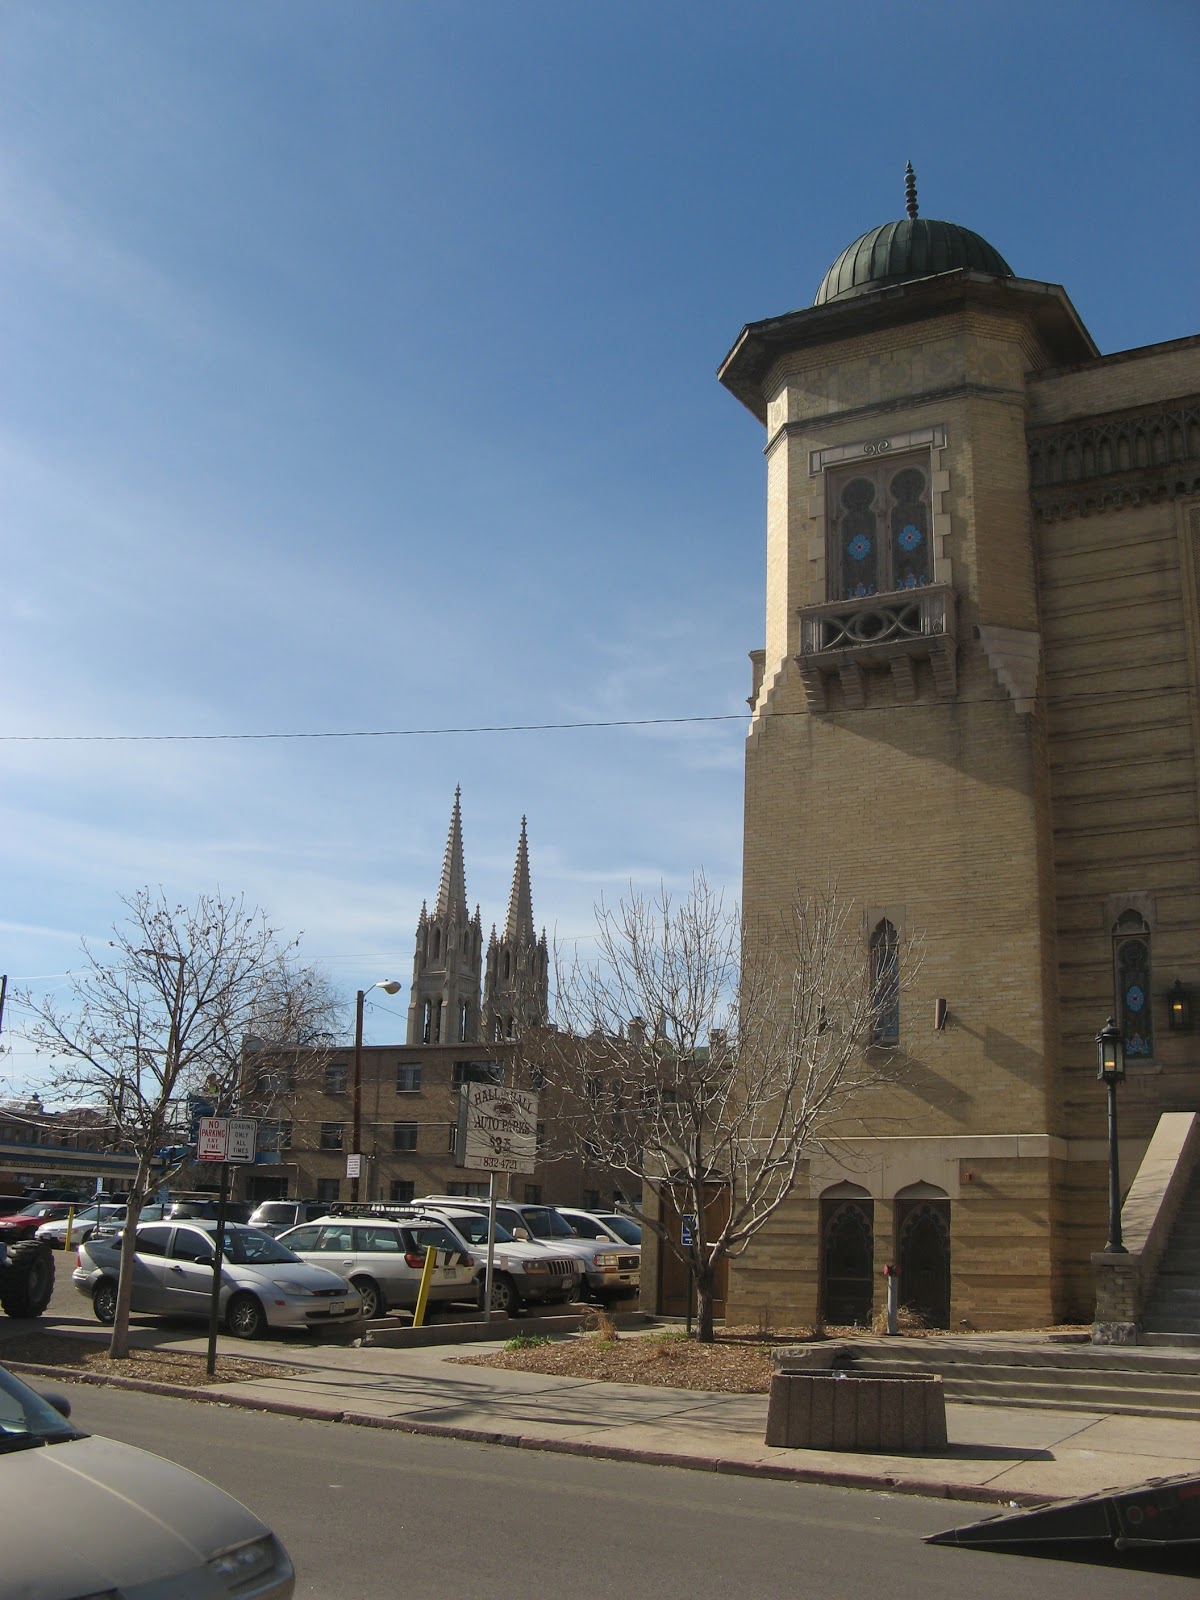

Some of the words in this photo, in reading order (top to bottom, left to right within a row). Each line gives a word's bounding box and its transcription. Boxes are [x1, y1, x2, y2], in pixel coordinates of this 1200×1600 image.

[474, 1088, 498, 1105] HALL
[208, 1120, 220, 1129] NO
[474, 1115, 499, 1130] AUTO
[201, 1128, 226, 1138] PARKING
[483, 1157, 518, 1170] 832-4721
